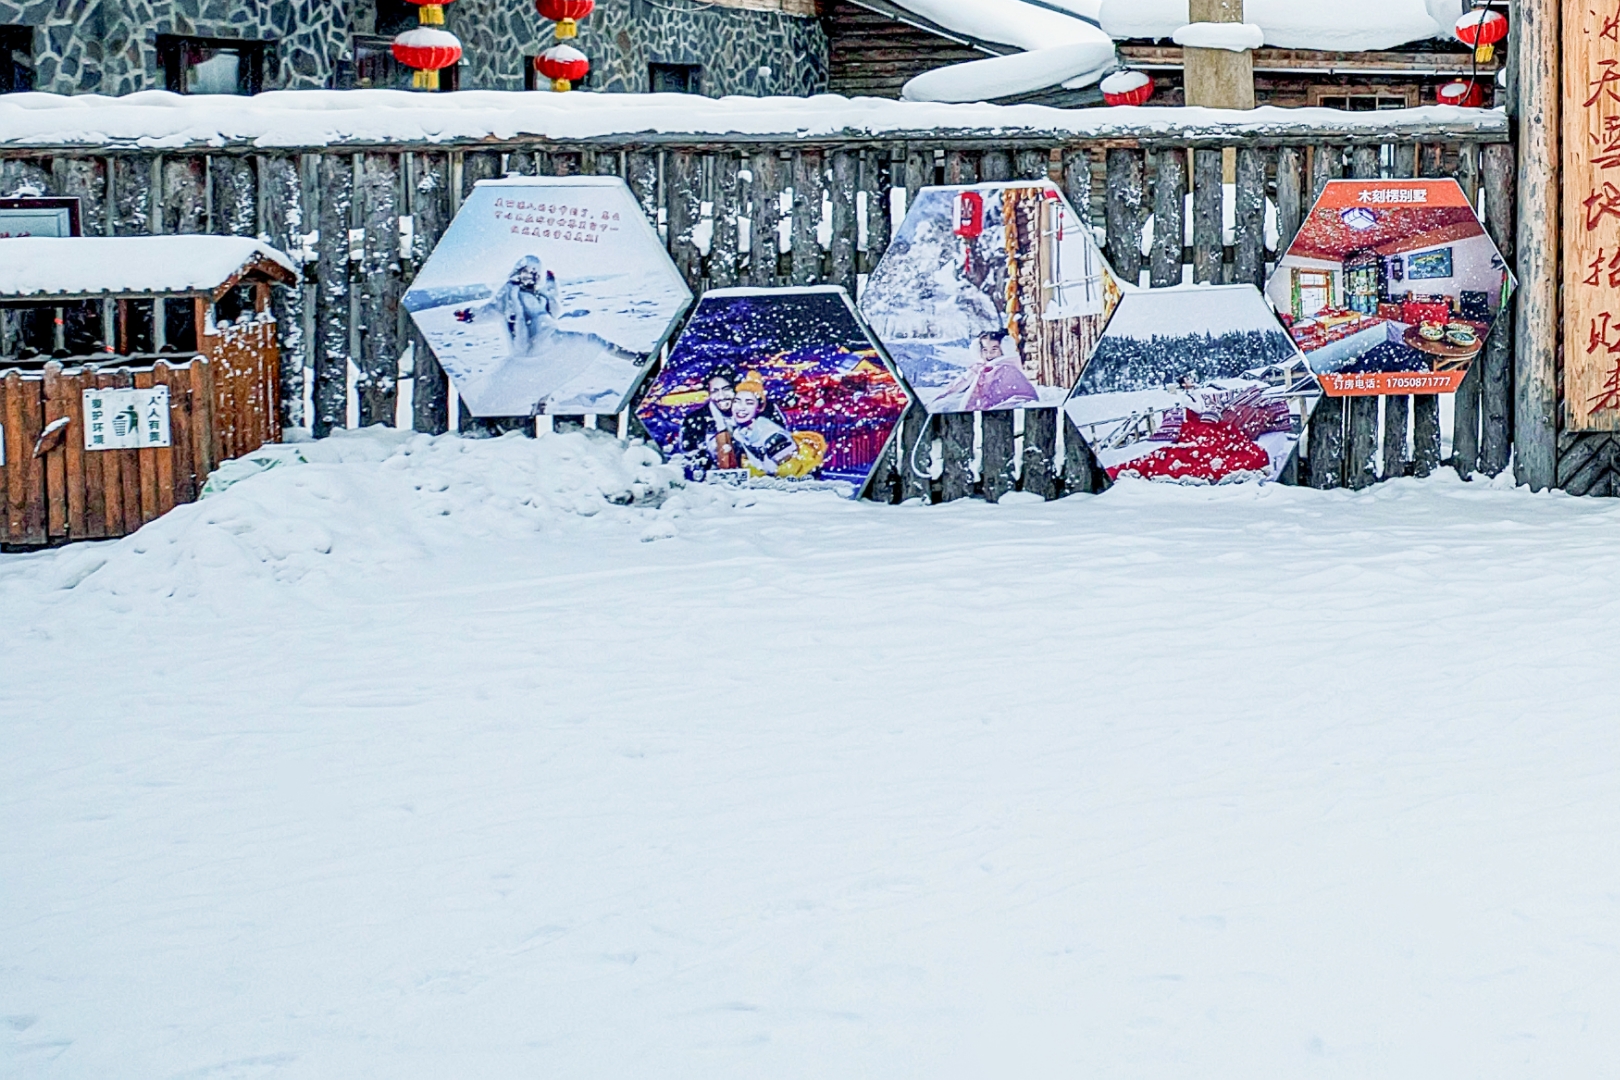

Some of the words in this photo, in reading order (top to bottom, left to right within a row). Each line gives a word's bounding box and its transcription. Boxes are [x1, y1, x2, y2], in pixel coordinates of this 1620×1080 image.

[1357, 188, 1428, 204] 木刻楞别墅
[1386, 376, 1451, 389] 17050871777
[91, 398, 105, 445] 爱护环境
[146, 396, 160, 443] 人人有责
